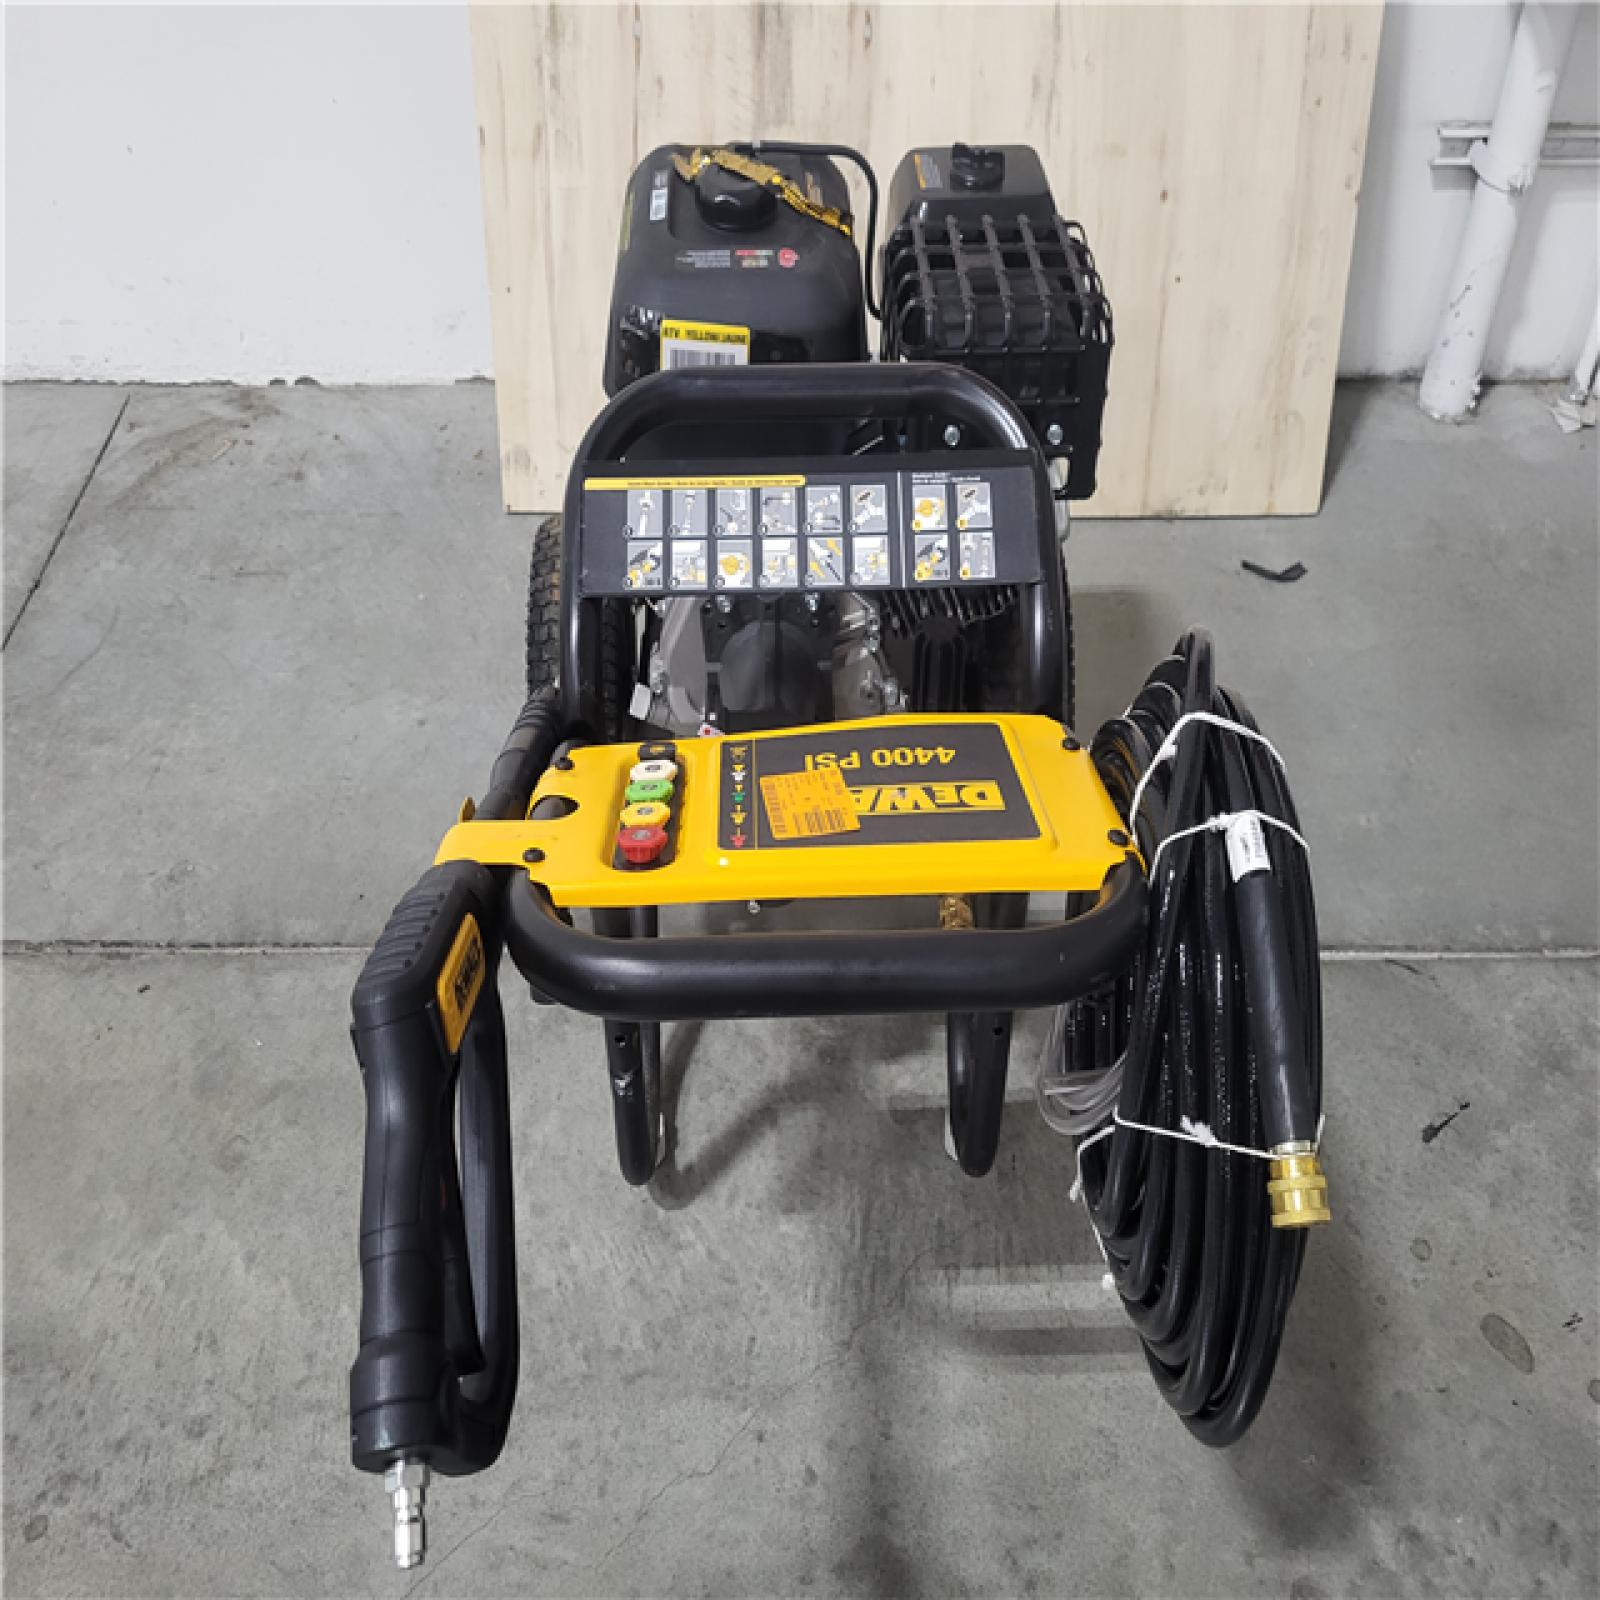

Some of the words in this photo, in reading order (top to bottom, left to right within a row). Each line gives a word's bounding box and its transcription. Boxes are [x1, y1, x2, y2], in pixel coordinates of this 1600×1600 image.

[804, 751, 861, 771] PSI
[871, 747, 956, 766] 4400
[848, 785, 1005, 813] DEWA
